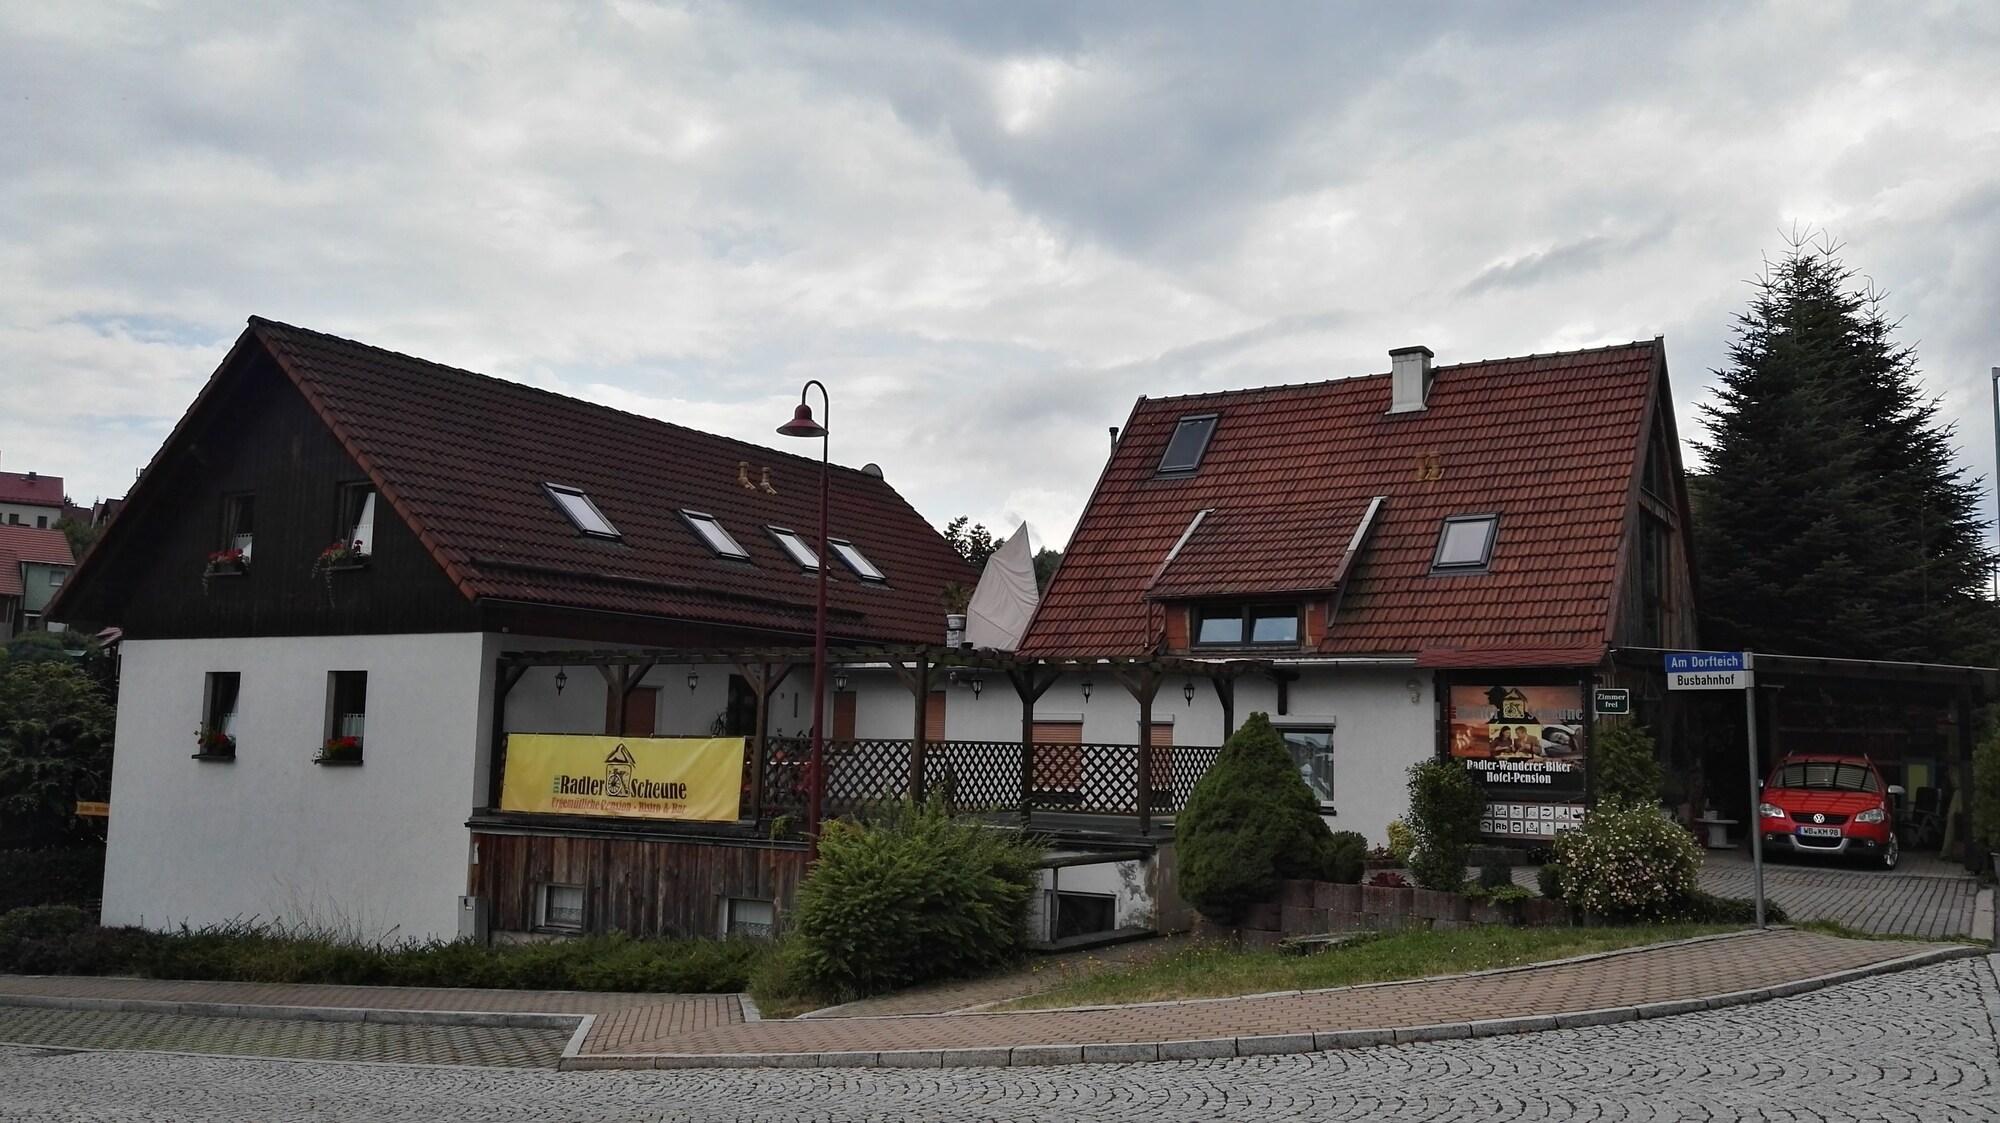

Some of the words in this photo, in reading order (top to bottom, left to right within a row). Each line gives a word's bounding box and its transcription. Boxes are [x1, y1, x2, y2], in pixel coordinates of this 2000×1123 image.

[1671, 656, 1687, 668] Am
[1691, 655, 1738, 667] Dorfteich
[1677, 673, 1735, 686] Busbahnhof
[1597, 693, 1626, 701] Zimmer
[1486, 771, 1552, 784] Hotel-Pension
[560, 775, 605, 796] Radler
[631, 779, 687, 800] Scheune
